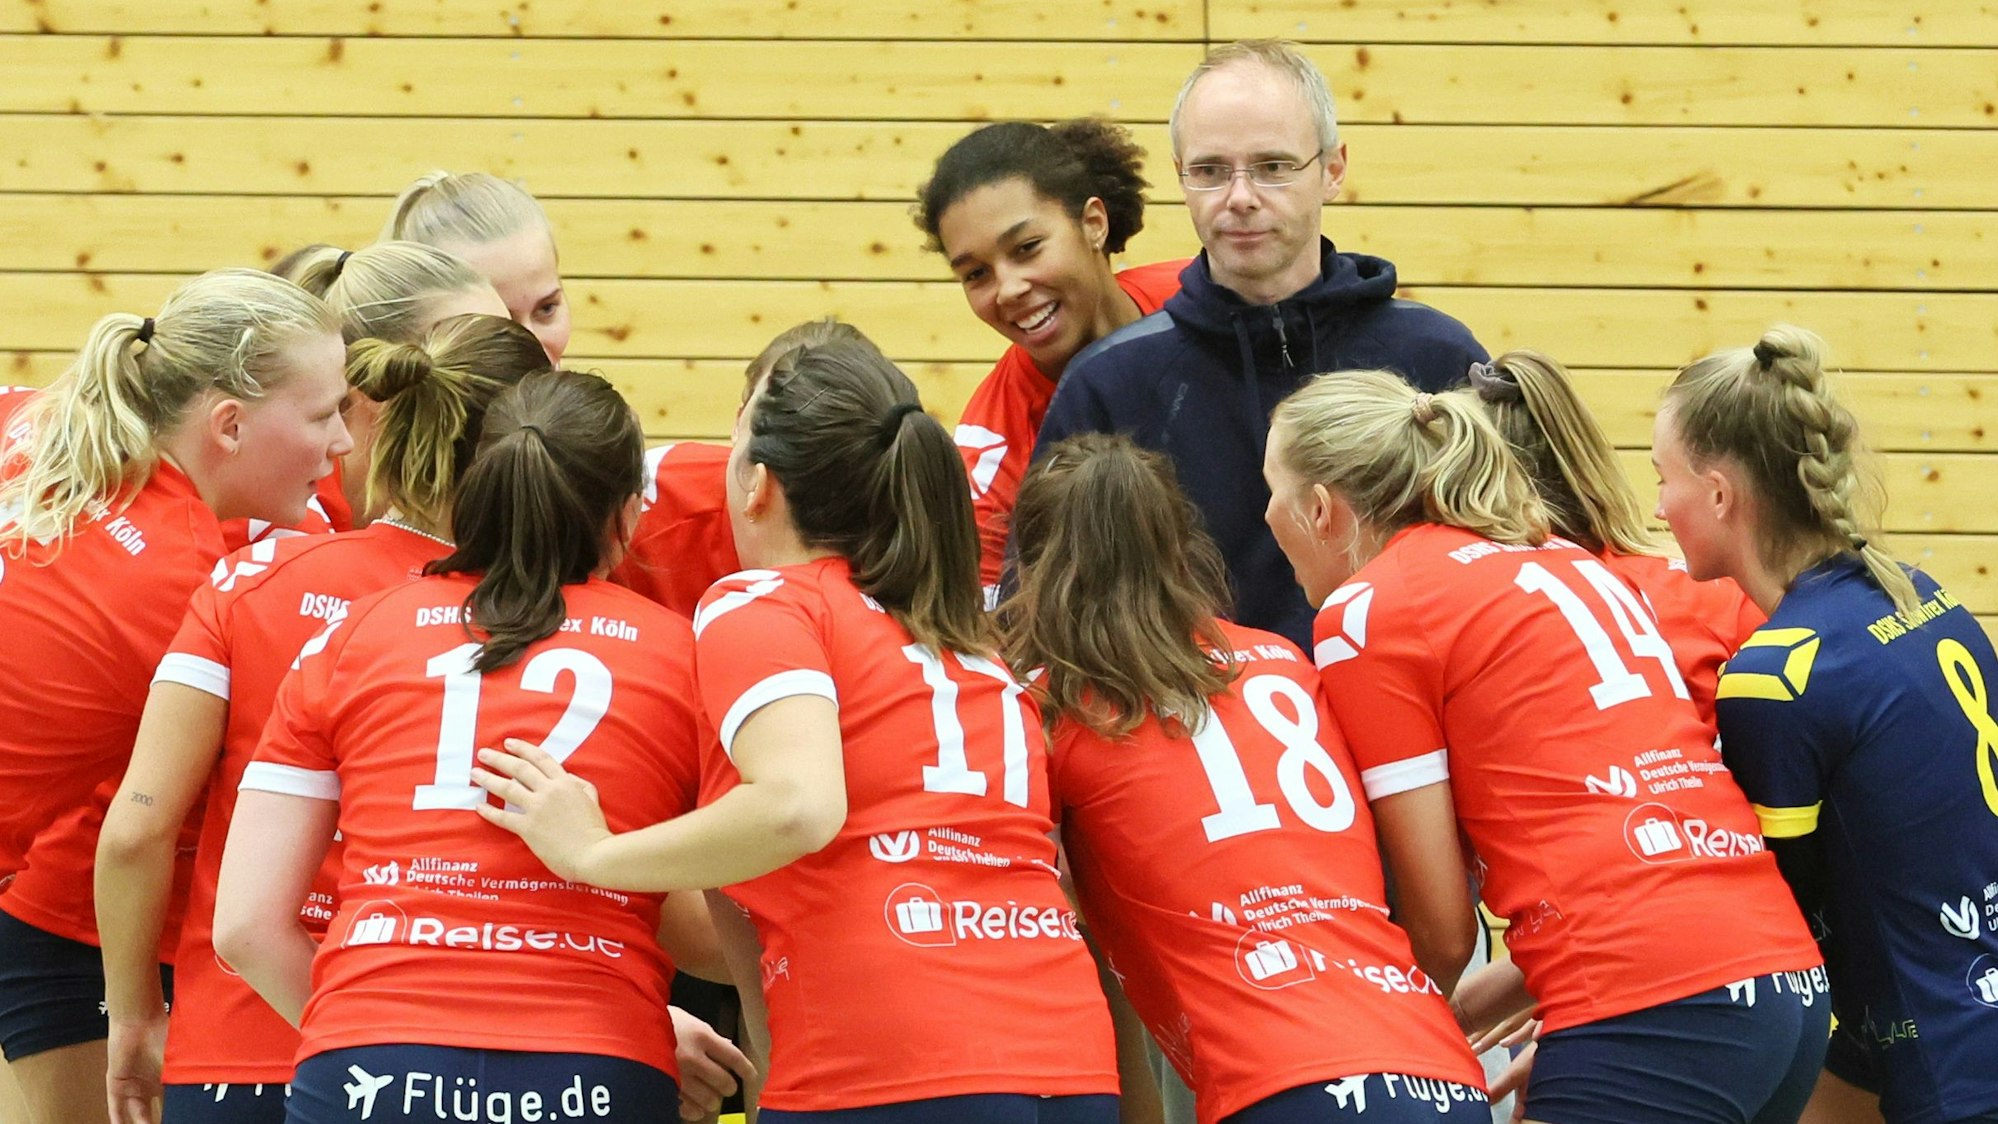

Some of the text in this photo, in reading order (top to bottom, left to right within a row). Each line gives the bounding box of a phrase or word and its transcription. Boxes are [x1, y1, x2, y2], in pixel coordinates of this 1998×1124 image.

[105, 516, 147, 556] Köln
[416, 606, 472, 627] DSHS
[591, 616, 638, 641] Köln
[1513, 559, 1691, 711] 14
[1253, 645, 1298, 662] Köln
[413, 642, 613, 814] 12
[901, 643, 1028, 809] 17
[1936, 638, 1998, 818] 8
[1190, 673, 1356, 843] 18
[1634, 748, 1683, 767] Allfinanz
[1640, 762, 1689, 781] Deutsche
[928, 827, 981, 847] Allfinanz
[406, 869, 476, 888] Deutsche
[410, 857, 478, 873] Allfinanz
[1240, 883, 1304, 907] Allfinanz
[403, 1071, 611, 1124] Flüge.de
